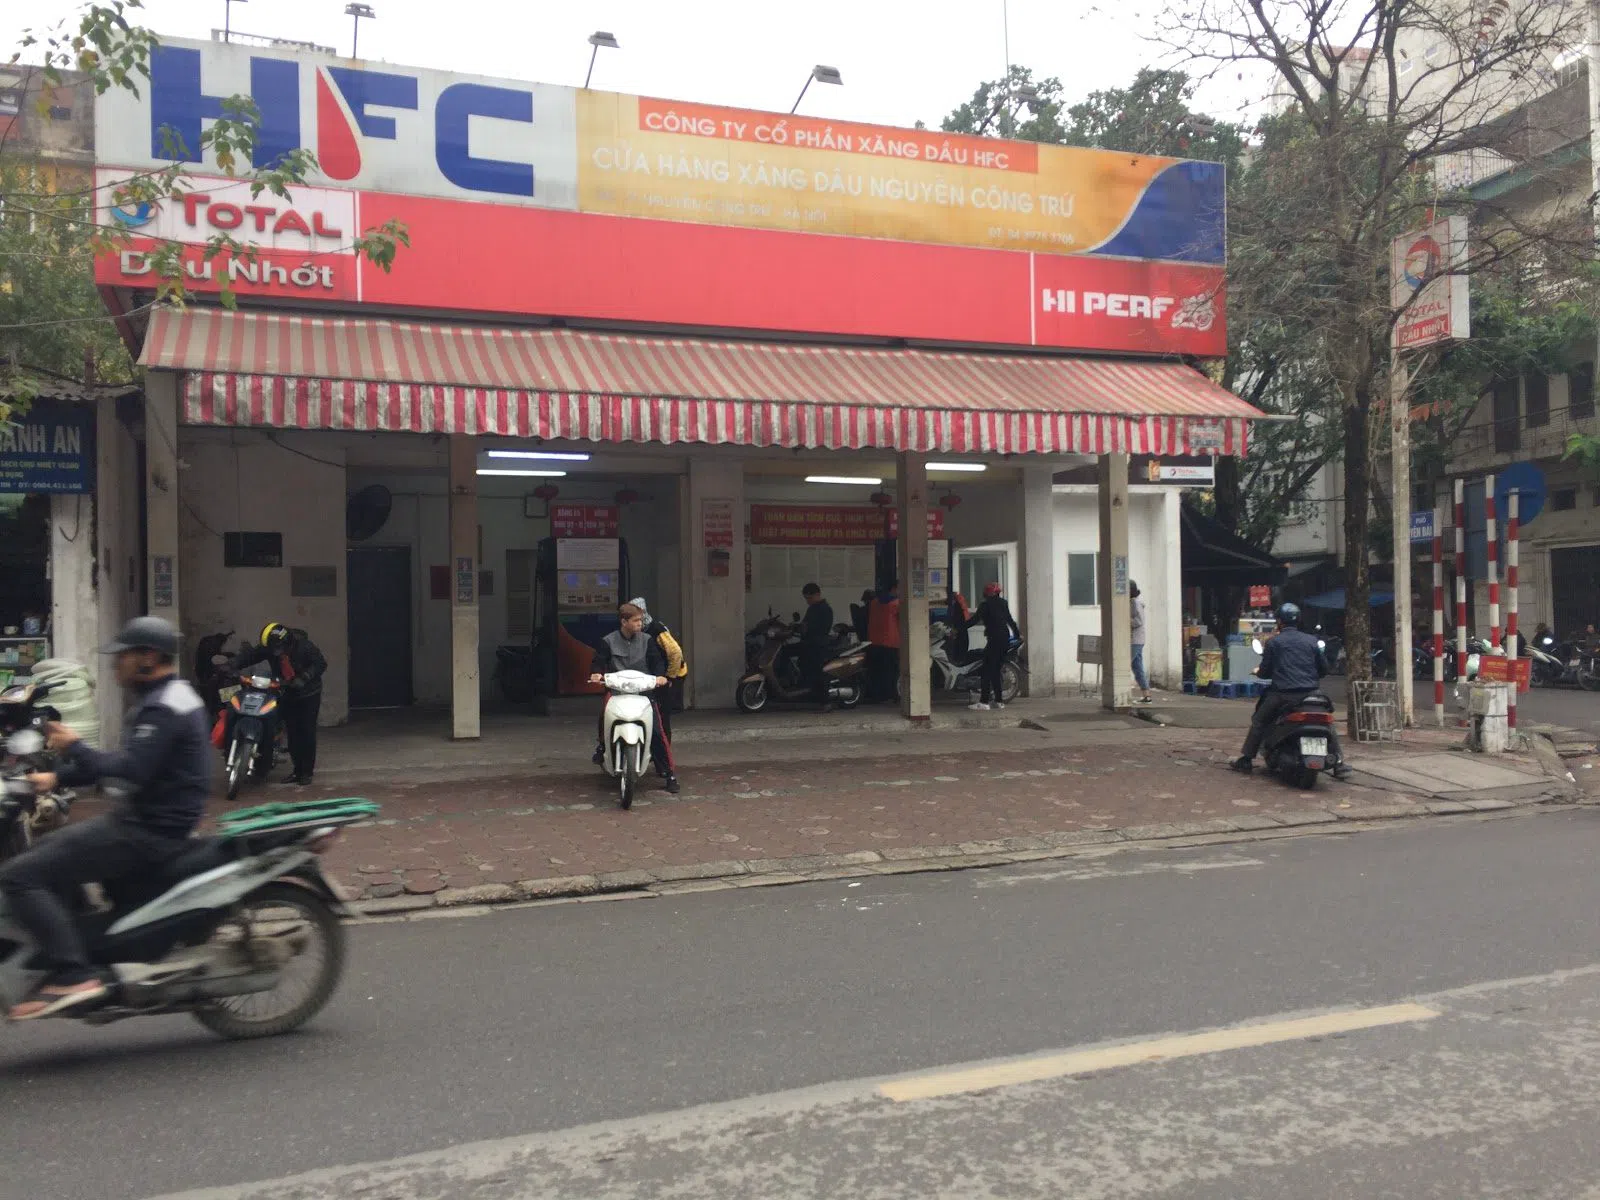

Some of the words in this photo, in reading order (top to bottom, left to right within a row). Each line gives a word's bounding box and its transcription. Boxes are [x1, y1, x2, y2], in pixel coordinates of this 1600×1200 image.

[150, 45, 533, 197] HFC
[645, 111, 716, 136] CÔNG
[723, 120, 746, 139] TY
[754, 119, 787, 144] CỔ
[858, 134, 919, 158] XĂNG
[974, 150, 1009, 169] HFC
[592, 139, 650, 175] CỬA
[657, 150, 729, 183] HÀNG
[739, 160, 808, 190] XĂNG
[870, 174, 964, 208] NGUYỄN
[971, 186, 1033, 214] CÔNG
[172, 193, 342, 239] TOTAL
[120, 249, 212, 280] Du
[228, 257, 334, 288] Nhớt
[1042, 288, 1076, 313] HI
[1083, 291, 1174, 319] PERF
[53, 425, 80, 454] AN
